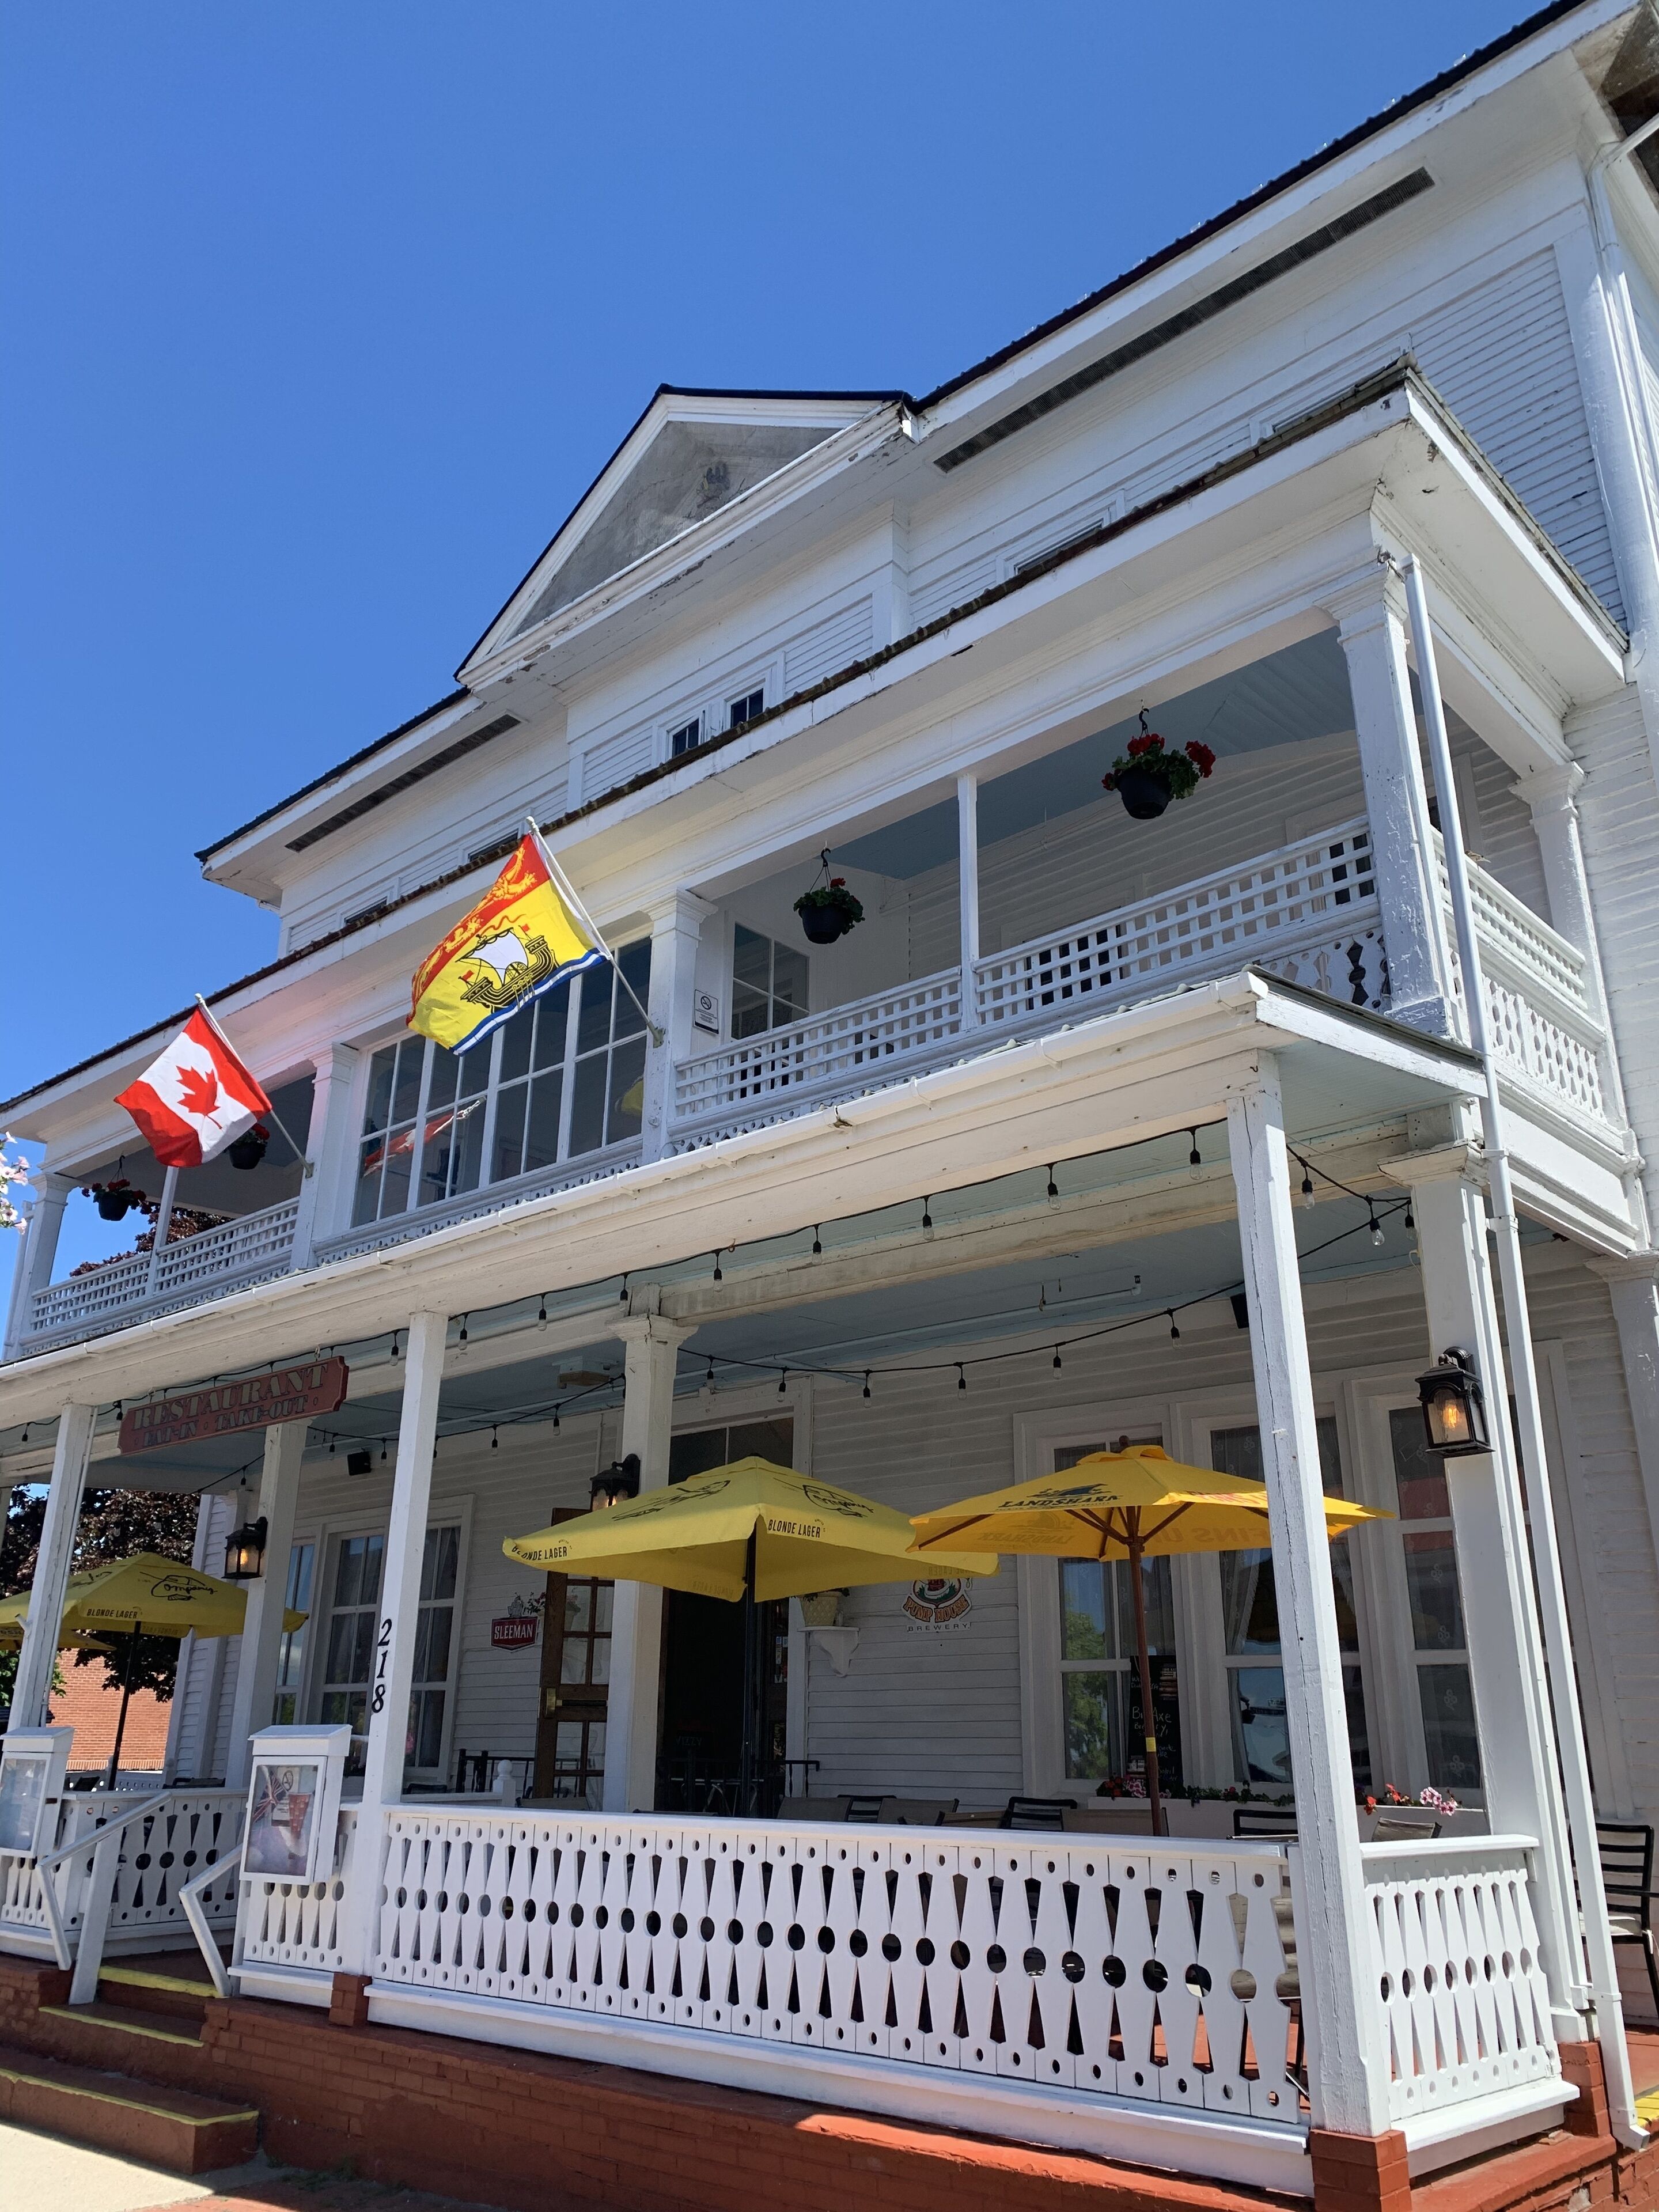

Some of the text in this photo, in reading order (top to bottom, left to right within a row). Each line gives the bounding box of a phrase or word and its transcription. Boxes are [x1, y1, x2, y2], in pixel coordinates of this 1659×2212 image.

[132, 1363, 328, 1430] RESTAURANT
[143, 1395, 308, 1447] EAT-IN TAKE-OUT
[768, 1519, 797, 1534] BLONDE
[798, 1524, 821, 1538] LAGER
[512, 1545, 567, 1560] BLONDE LAGER
[86, 1608, 113, 1617] BLONDE
[115, 1609, 138, 1619] LAGER
[903, 1594, 970, 1623] PUMP HOUSE
[494, 1624, 533, 1639] SLEEMAN
[908, 1623, 968, 1632] BREWERY
[372, 1619, 392, 1713] 218
